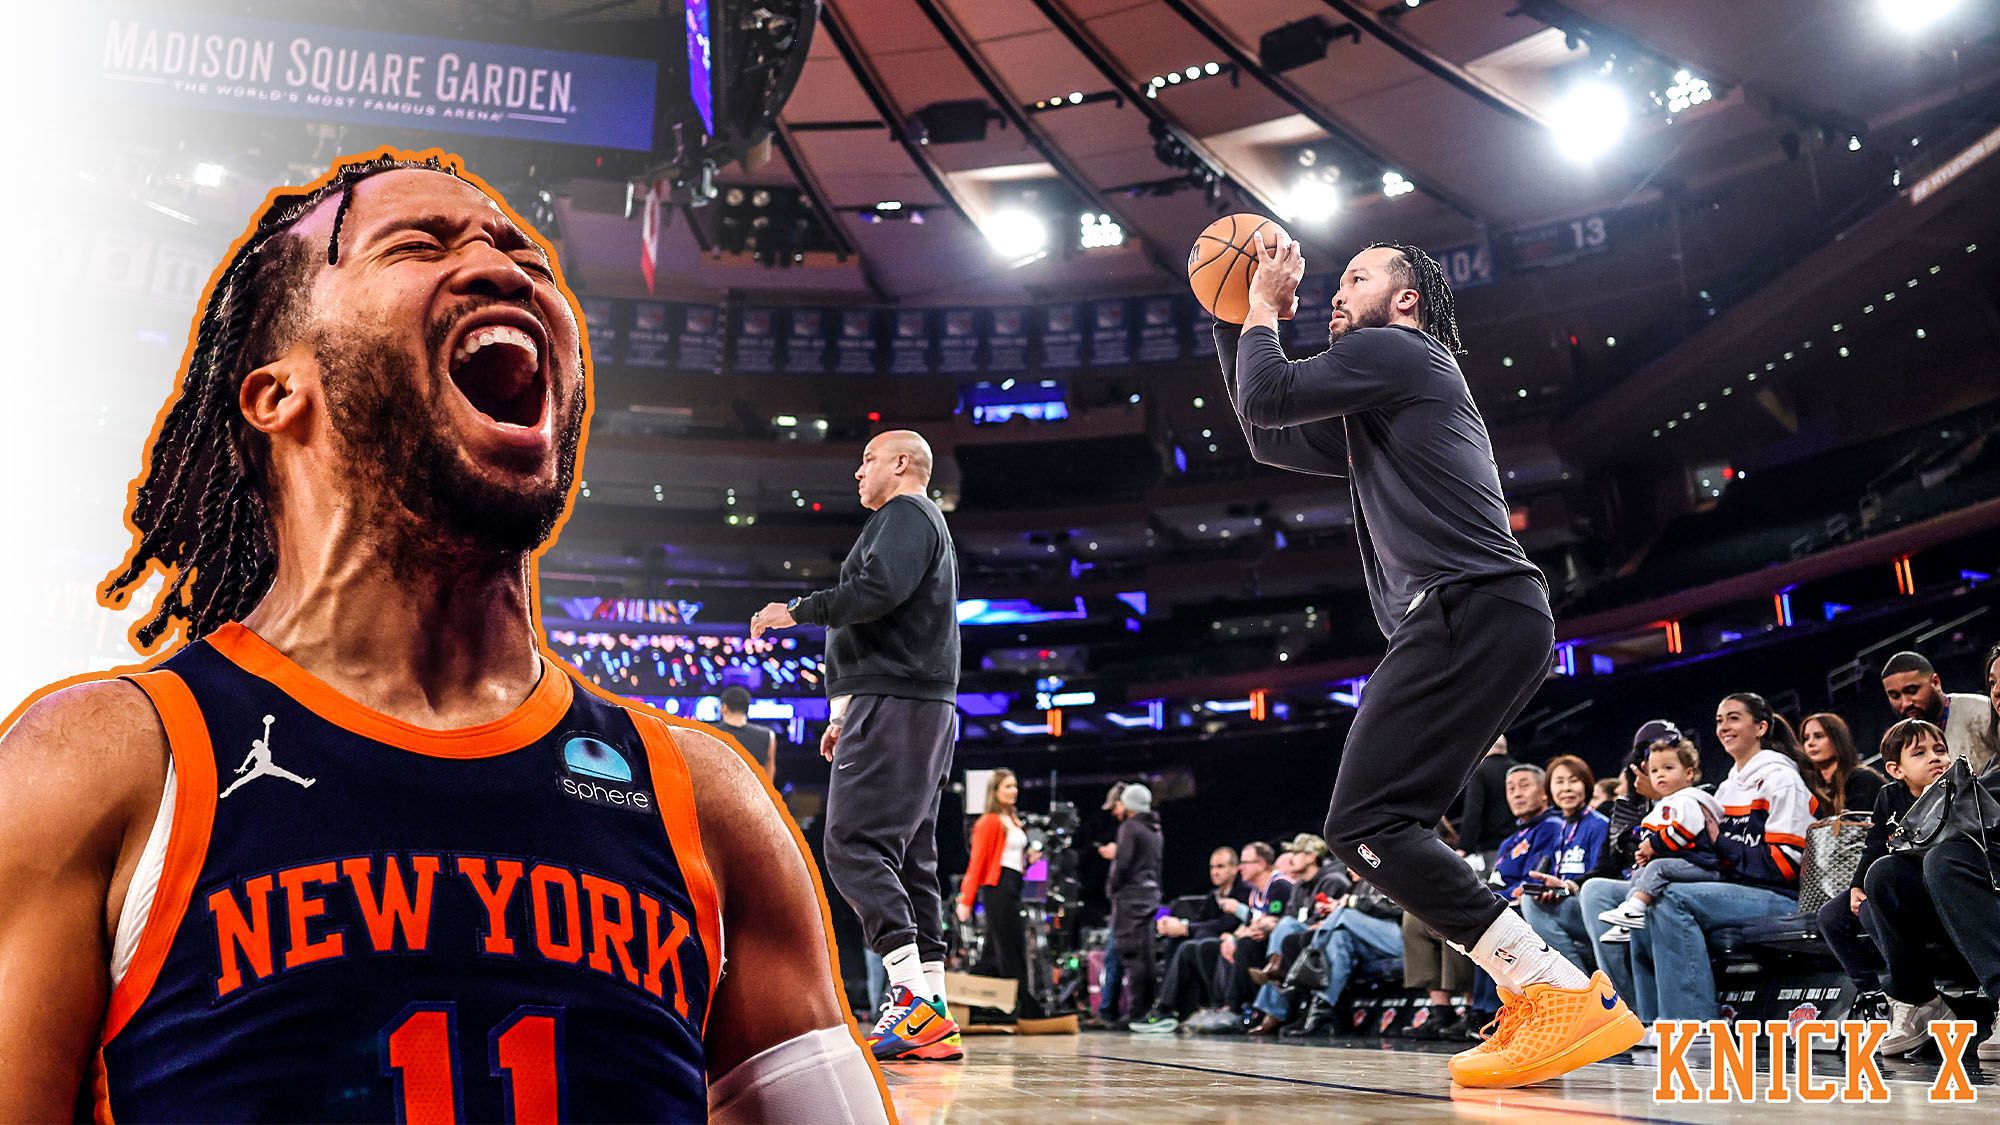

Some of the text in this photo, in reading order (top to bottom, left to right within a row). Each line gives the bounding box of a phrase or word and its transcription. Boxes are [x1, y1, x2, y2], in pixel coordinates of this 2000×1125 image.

[102, 18, 275, 84] MADISON
[285, 37, 425, 98] SQUARE
[174, 79, 502, 123] THE WORLD'S MOST FAMOUS ARENA
[1569, 216, 1607, 250] 13
[563, 779, 649, 809] sphere
[207, 855, 690, 1016] NEW YORK
[384, 1006, 562, 1125] 11
